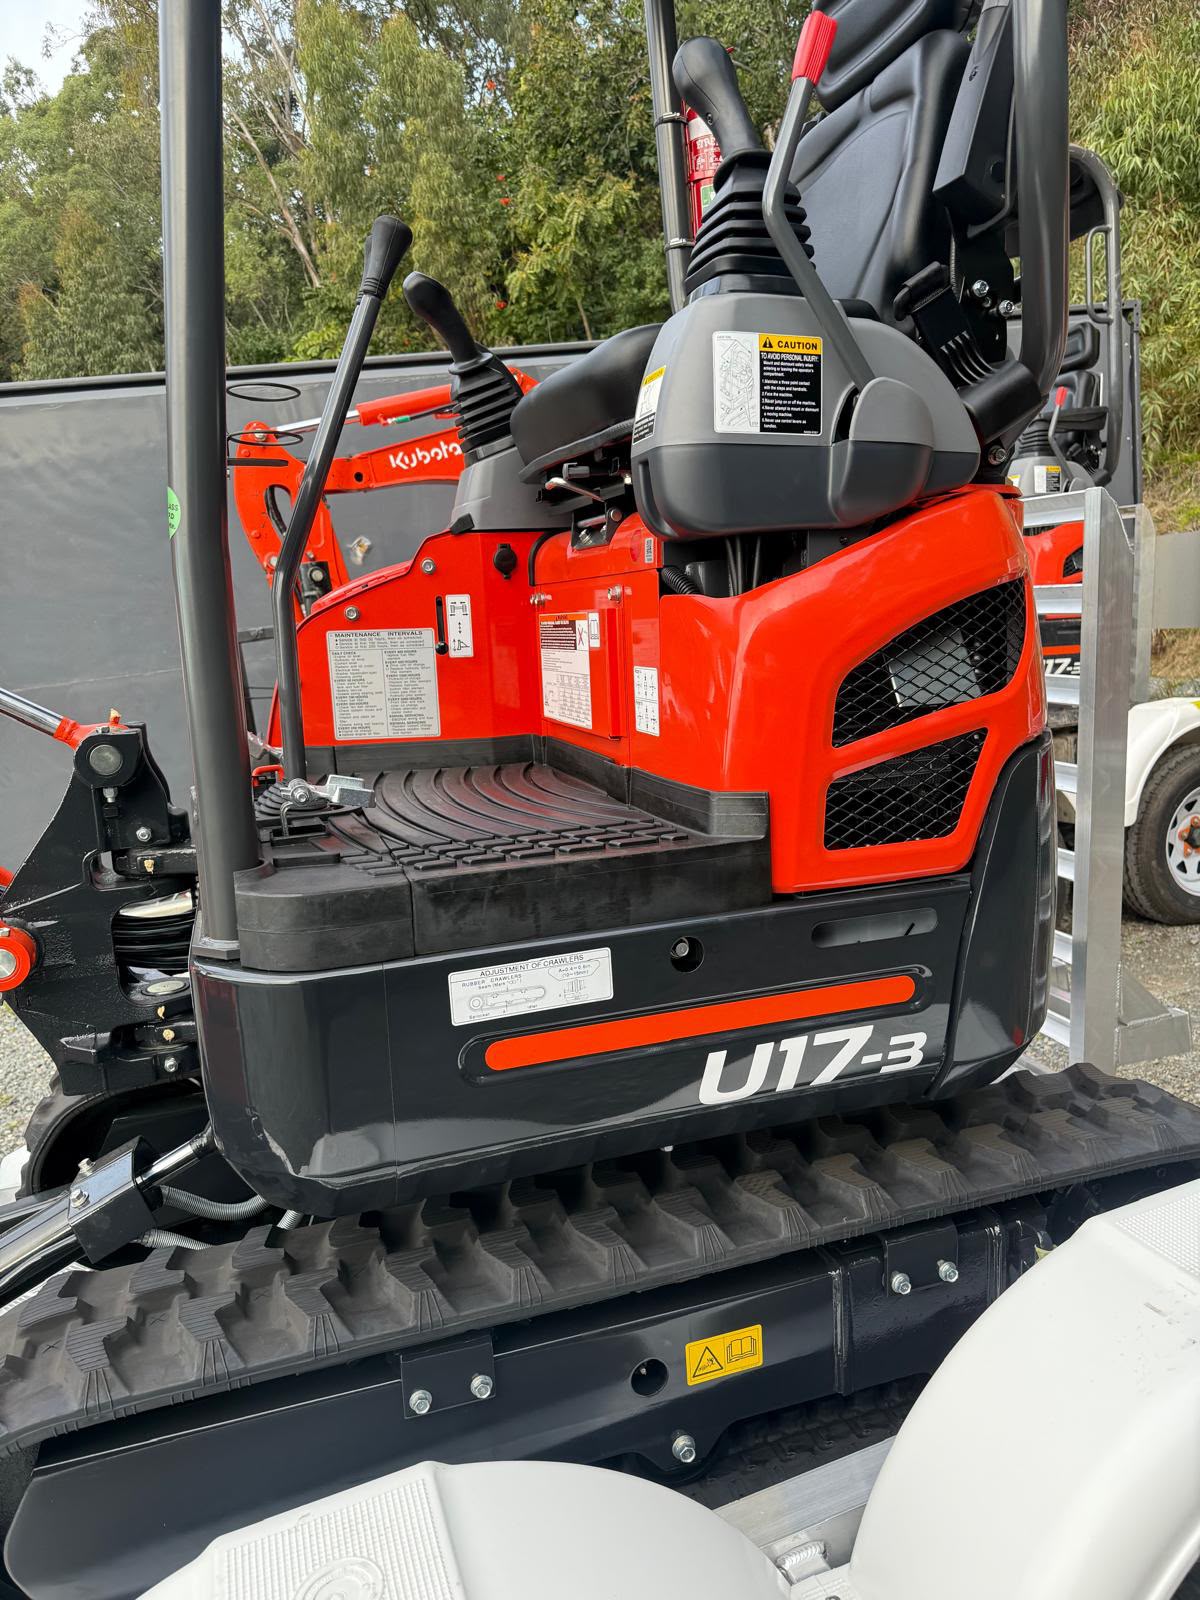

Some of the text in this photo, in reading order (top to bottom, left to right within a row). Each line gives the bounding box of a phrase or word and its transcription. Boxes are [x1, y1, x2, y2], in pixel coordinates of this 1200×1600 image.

[778, 340, 818, 350] CAUTION
[389, 441, 463, 470] Kubota
[1043, 658, 1080, 674] 17-3
[480, 963, 530, 976] ADJUSTMENT
[544, 954, 584, 967] CRAWLERS
[490, 974, 522, 982] CRAWLERS
[699, 1025, 927, 1104] U17-3
